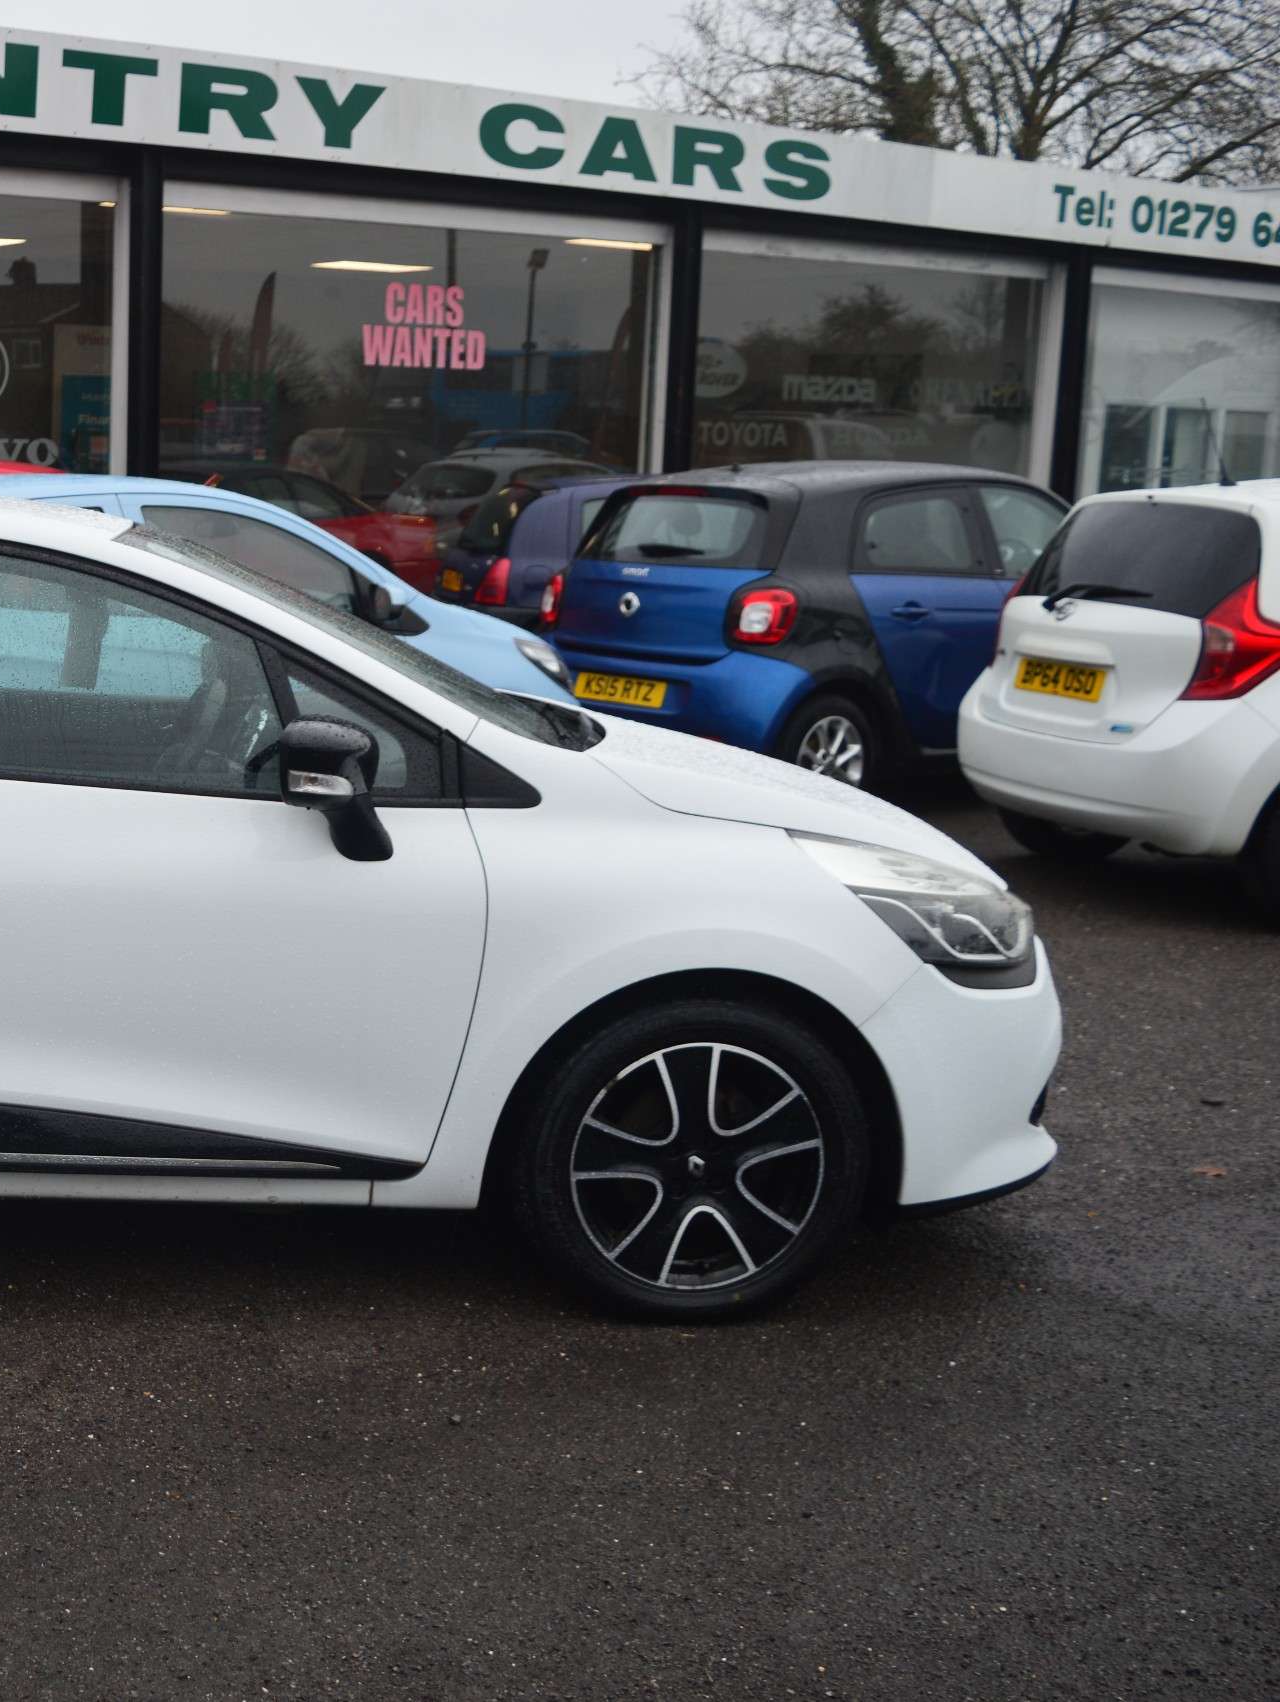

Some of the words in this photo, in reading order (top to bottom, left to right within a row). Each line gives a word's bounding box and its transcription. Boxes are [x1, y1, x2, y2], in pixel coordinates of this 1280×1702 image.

[478, 102, 833, 200] CARS
[1054, 184, 1115, 228] Tel:
[1132, 195, 1236, 243] 01279
[1253, 211, 1280, 247] 6
[384, 281, 464, 327] CARS
[362, 324, 486, 370] WANTED
[782, 373, 876, 403] mazda
[697, 421, 787, 448] TOYOTA
[583, 674, 618, 698] KS15
[620, 679, 656, 702] RTZ
